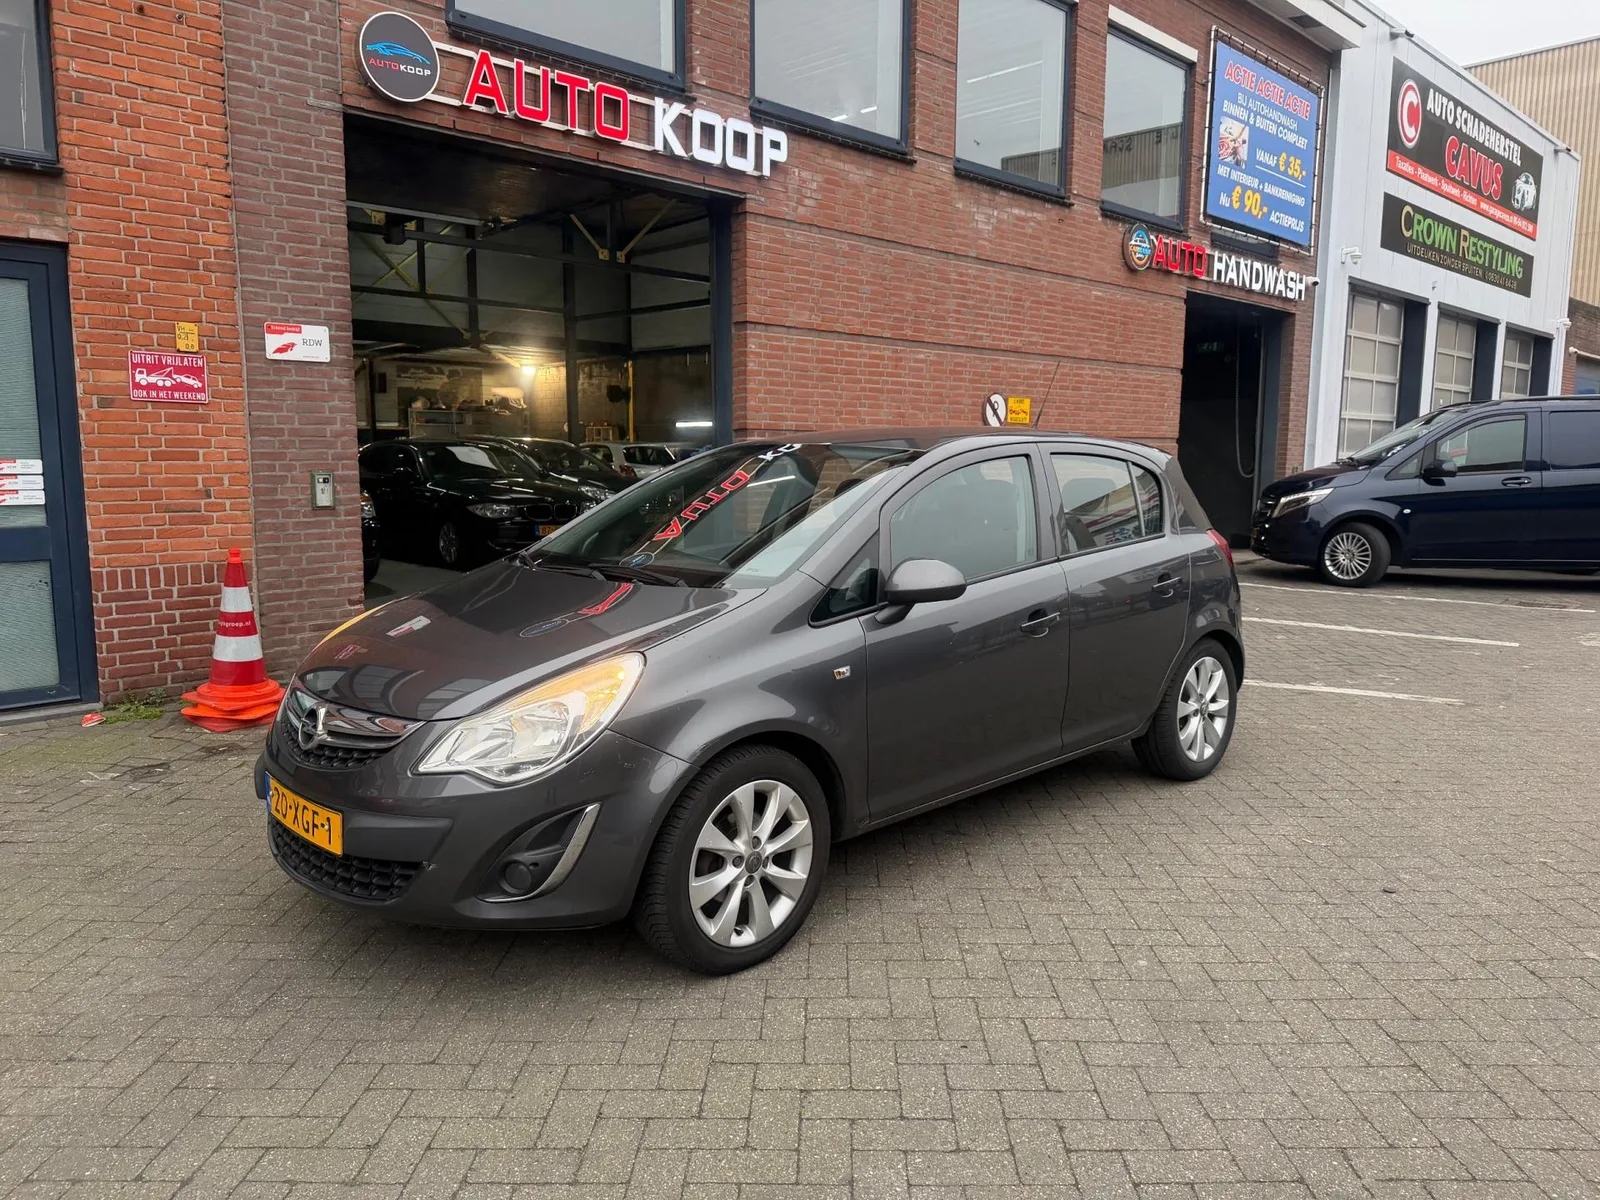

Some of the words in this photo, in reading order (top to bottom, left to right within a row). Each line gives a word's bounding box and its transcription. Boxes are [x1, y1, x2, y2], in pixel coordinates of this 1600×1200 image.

[369, 57, 431, 76] AUTOKOOP
[1225, 61, 1256, 92] ACTIE
[1256, 77, 1285, 107] ACTIE
[1284, 92, 1311, 120] ACTIE
[463, 49, 629, 142] AUTO
[654, 96, 788, 177] KOOP
[1223, 100, 1249, 119] BINNEN
[1248, 113, 1255, 125] &
[1255, 116, 1278, 136] BUITEN
[1278, 128, 1308, 150] COMPLEET
[1237, 92, 1247, 106] BIJ
[1248, 99, 1298, 132] AUTOHANDWASH
[1426, 89, 1454, 125] AUTO
[1455, 103, 1522, 167] SCHADEHERSTEL
[1256, 148, 1278, 167] VANAF
[1279, 152, 1287, 171] €
[1445, 135, 1504, 201] CAVUS
[1217, 164, 1230, 178] MET
[1230, 169, 1259, 191] INTERIEUR
[1264, 182, 1305, 207] BANKREINIGING
[1219, 192, 1231, 207] Nu
[1232, 185, 1242, 210] €
[1269, 210, 1305, 232] ACTIEPRIJS
[1401, 205, 1457, 254] CROWN
[1459, 228, 1524, 279] RESTYLING
[1152, 234, 1207, 278] AUTO
[1213, 251, 1306, 301] HANDWASH
[132, 353, 159, 365] UITRIT
[161, 355, 203, 368] VRIJLATEN
[302, 338, 323, 347] RDW
[133, 389, 148, 398] OOK
[149, 390, 157, 398] IN
[159, 390, 172, 399] HET
[173, 391, 206, 401] WEEKEND
[273, 786, 333, 845] 20-XGF-1
